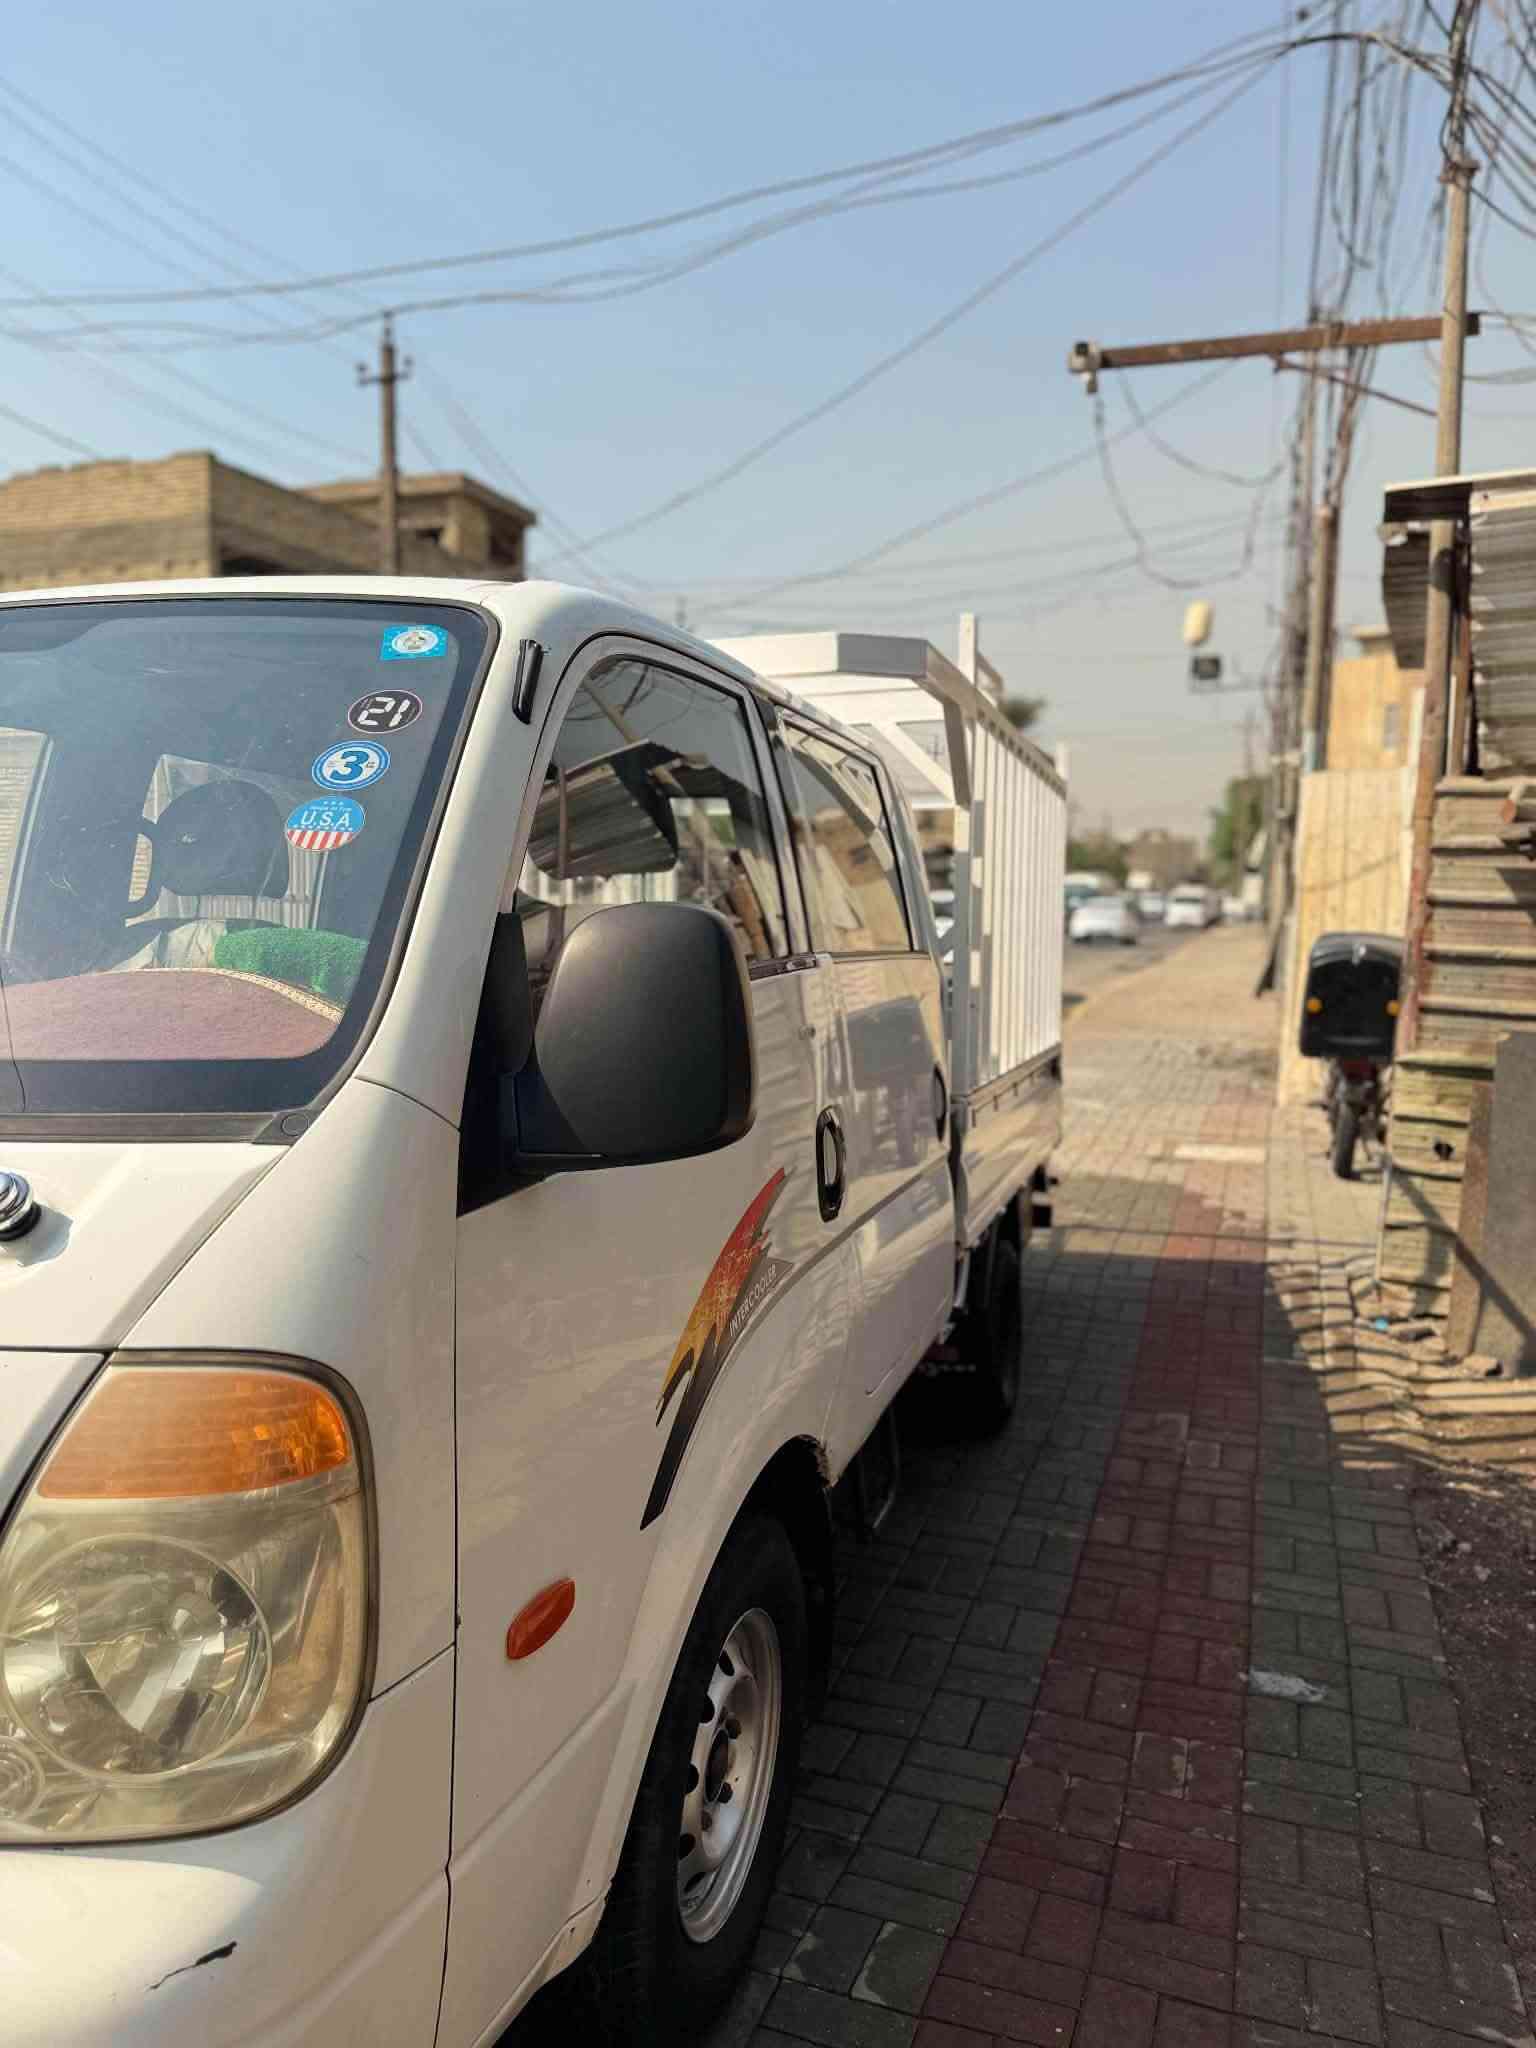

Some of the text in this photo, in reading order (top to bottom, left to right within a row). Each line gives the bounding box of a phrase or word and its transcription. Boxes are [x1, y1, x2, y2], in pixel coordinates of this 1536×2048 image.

[358, 696, 410, 727] 21
[330, 750, 369, 780] 3
[301, 809, 350, 827] U.S.A
[729, 1263, 777, 1337] INTERCOOLER
